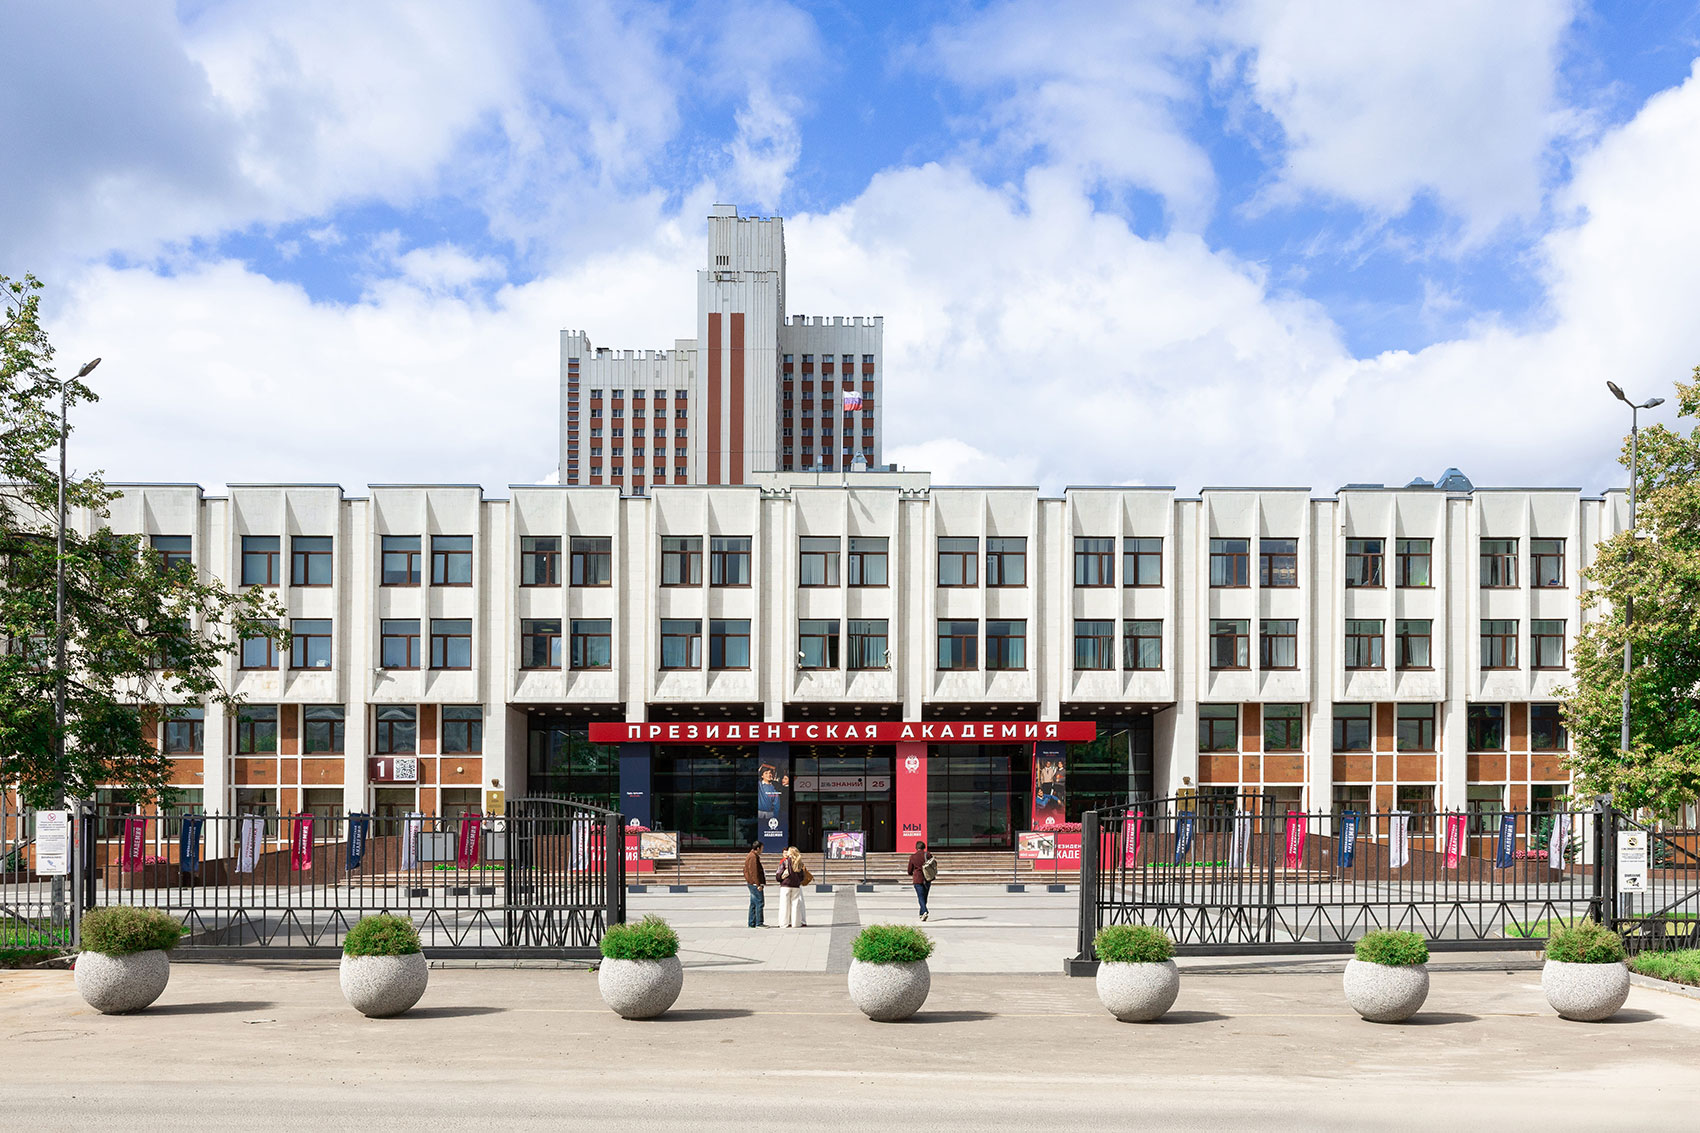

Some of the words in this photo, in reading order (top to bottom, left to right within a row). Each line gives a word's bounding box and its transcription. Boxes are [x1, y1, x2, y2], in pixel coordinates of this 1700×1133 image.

[627, 724, 878, 740] ПРЕЗИДЕНТСКАЯ
[900, 724, 1059, 740] АКАДЕМИЯ
[376, 760, 385, 778] 1
[902, 823, 922, 831] МЫ
[132, 827, 142, 858] АКАДЕМИЯ
[1056, 850, 1080, 859] КАДЕ
